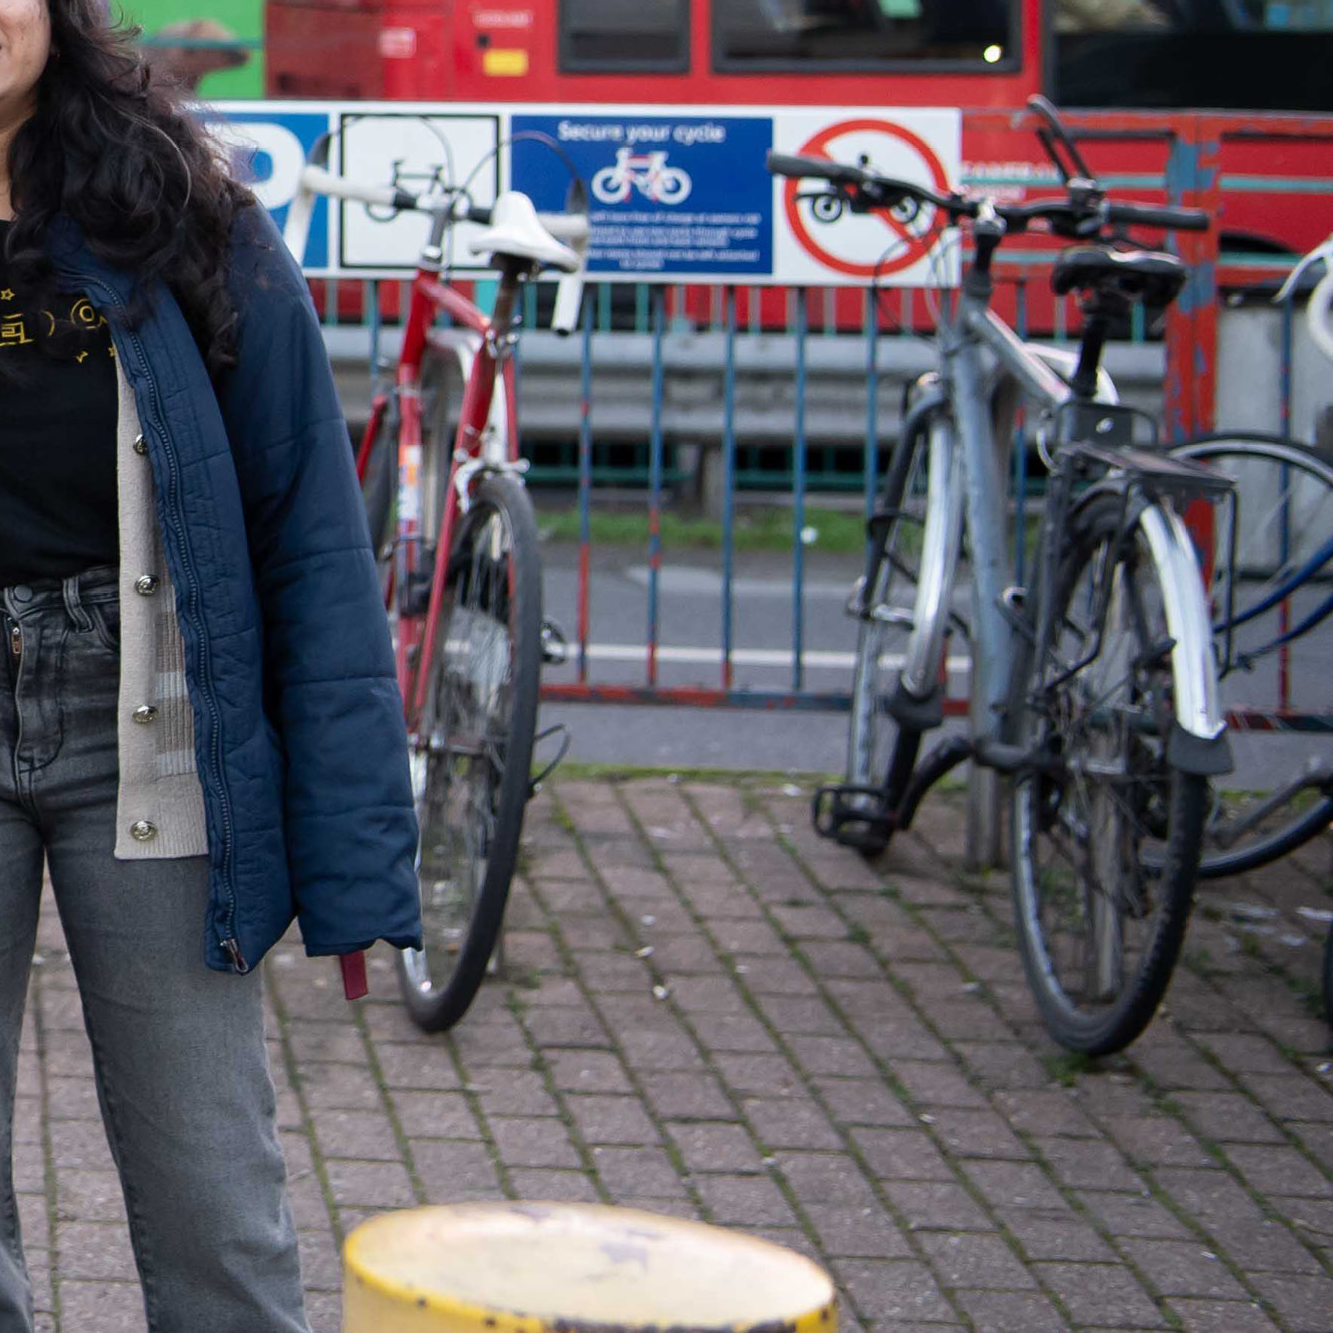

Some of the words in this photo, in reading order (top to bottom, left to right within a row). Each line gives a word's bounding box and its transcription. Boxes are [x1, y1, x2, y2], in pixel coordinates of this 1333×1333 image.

[558, 120, 624, 142] Secure
[627, 122, 671, 145] your
[674, 121, 726, 145] cycle
